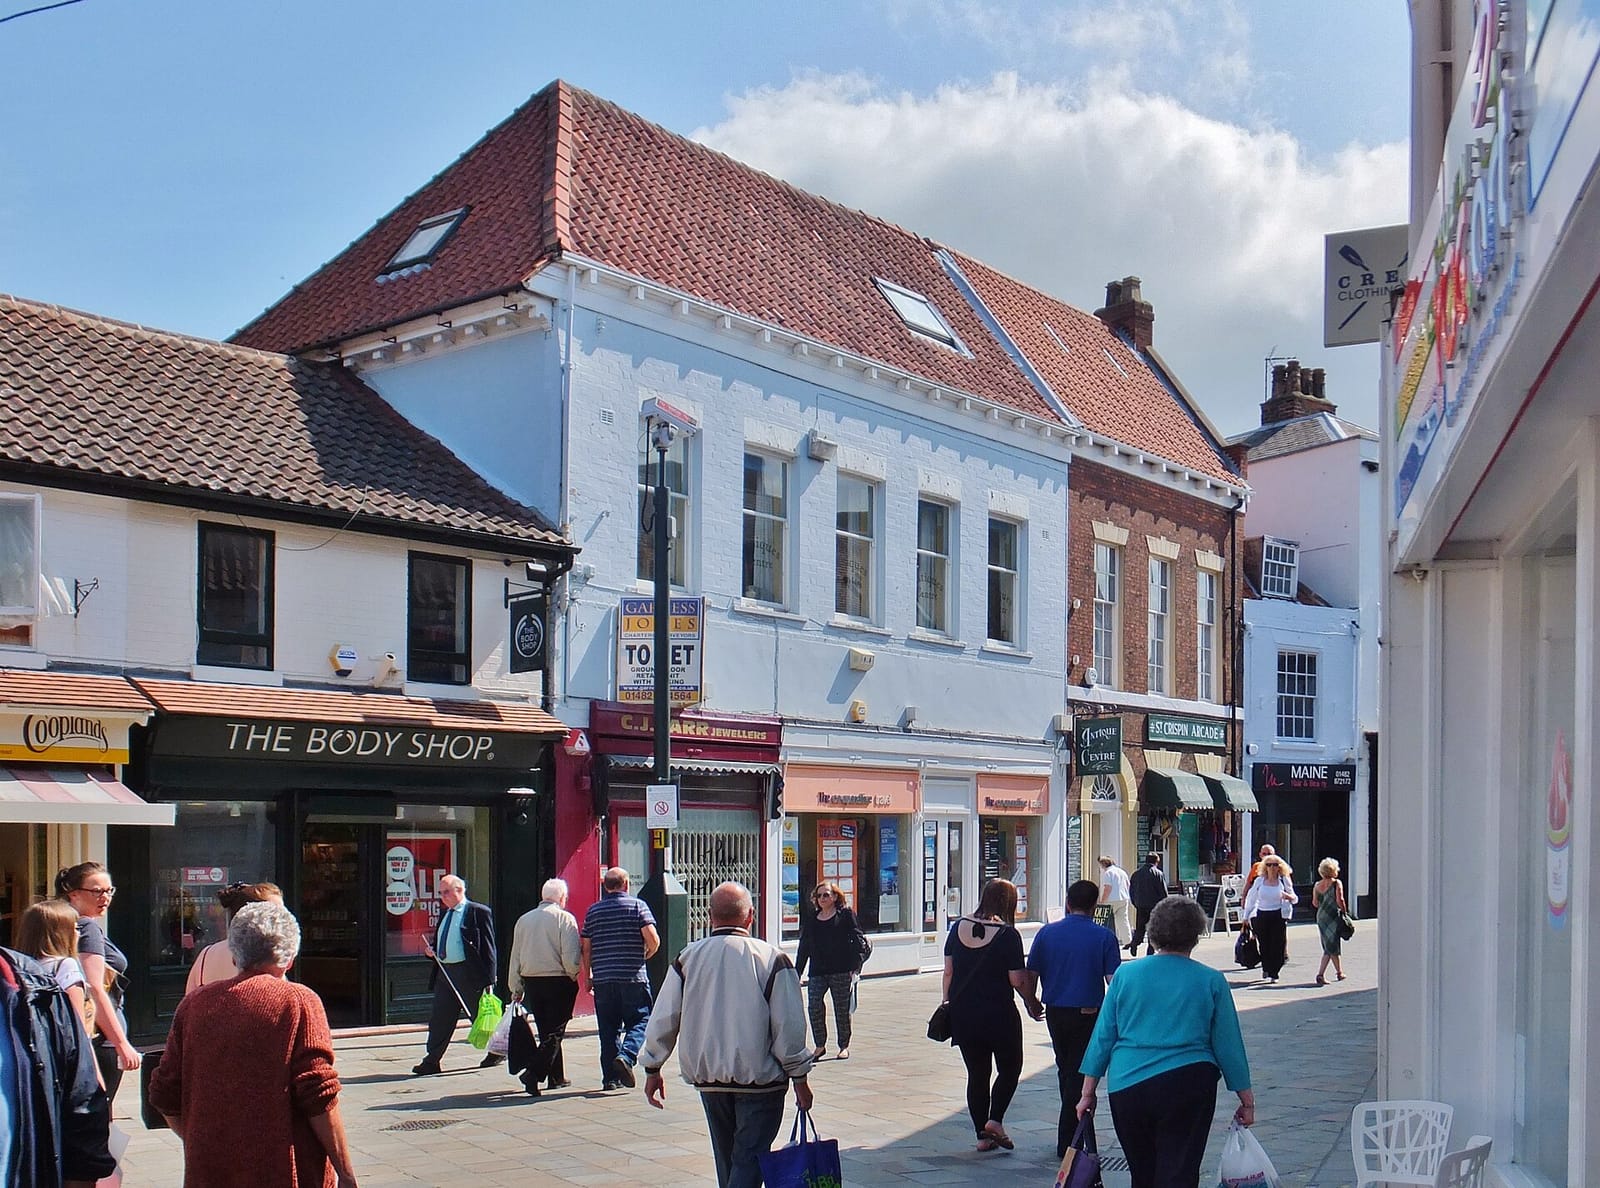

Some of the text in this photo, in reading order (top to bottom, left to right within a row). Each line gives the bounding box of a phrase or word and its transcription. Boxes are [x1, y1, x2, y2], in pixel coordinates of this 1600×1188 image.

[1338, 269, 1399, 289] CRE
[625, 601, 696, 615] GAESS
[625, 617, 696, 630] JOES
[625, 644, 695, 666] TO ET
[625, 692, 692, 700] 01482 564
[23, 714, 109, 754] Cooplands
[670, 719, 709, 736] ARR
[710, 726, 767, 740] JEWELLERS
[1080, 727, 1117, 748] ANTIQUE
[1163, 722, 1189, 736] CRISPIN
[1191, 724, 1219, 740] ARCADE
[226, 723, 296, 752] THE
[306, 728, 404, 756] BODY
[1081, 749, 1116, 767] CENTRE
[1291, 765, 1329, 779] MAINE
